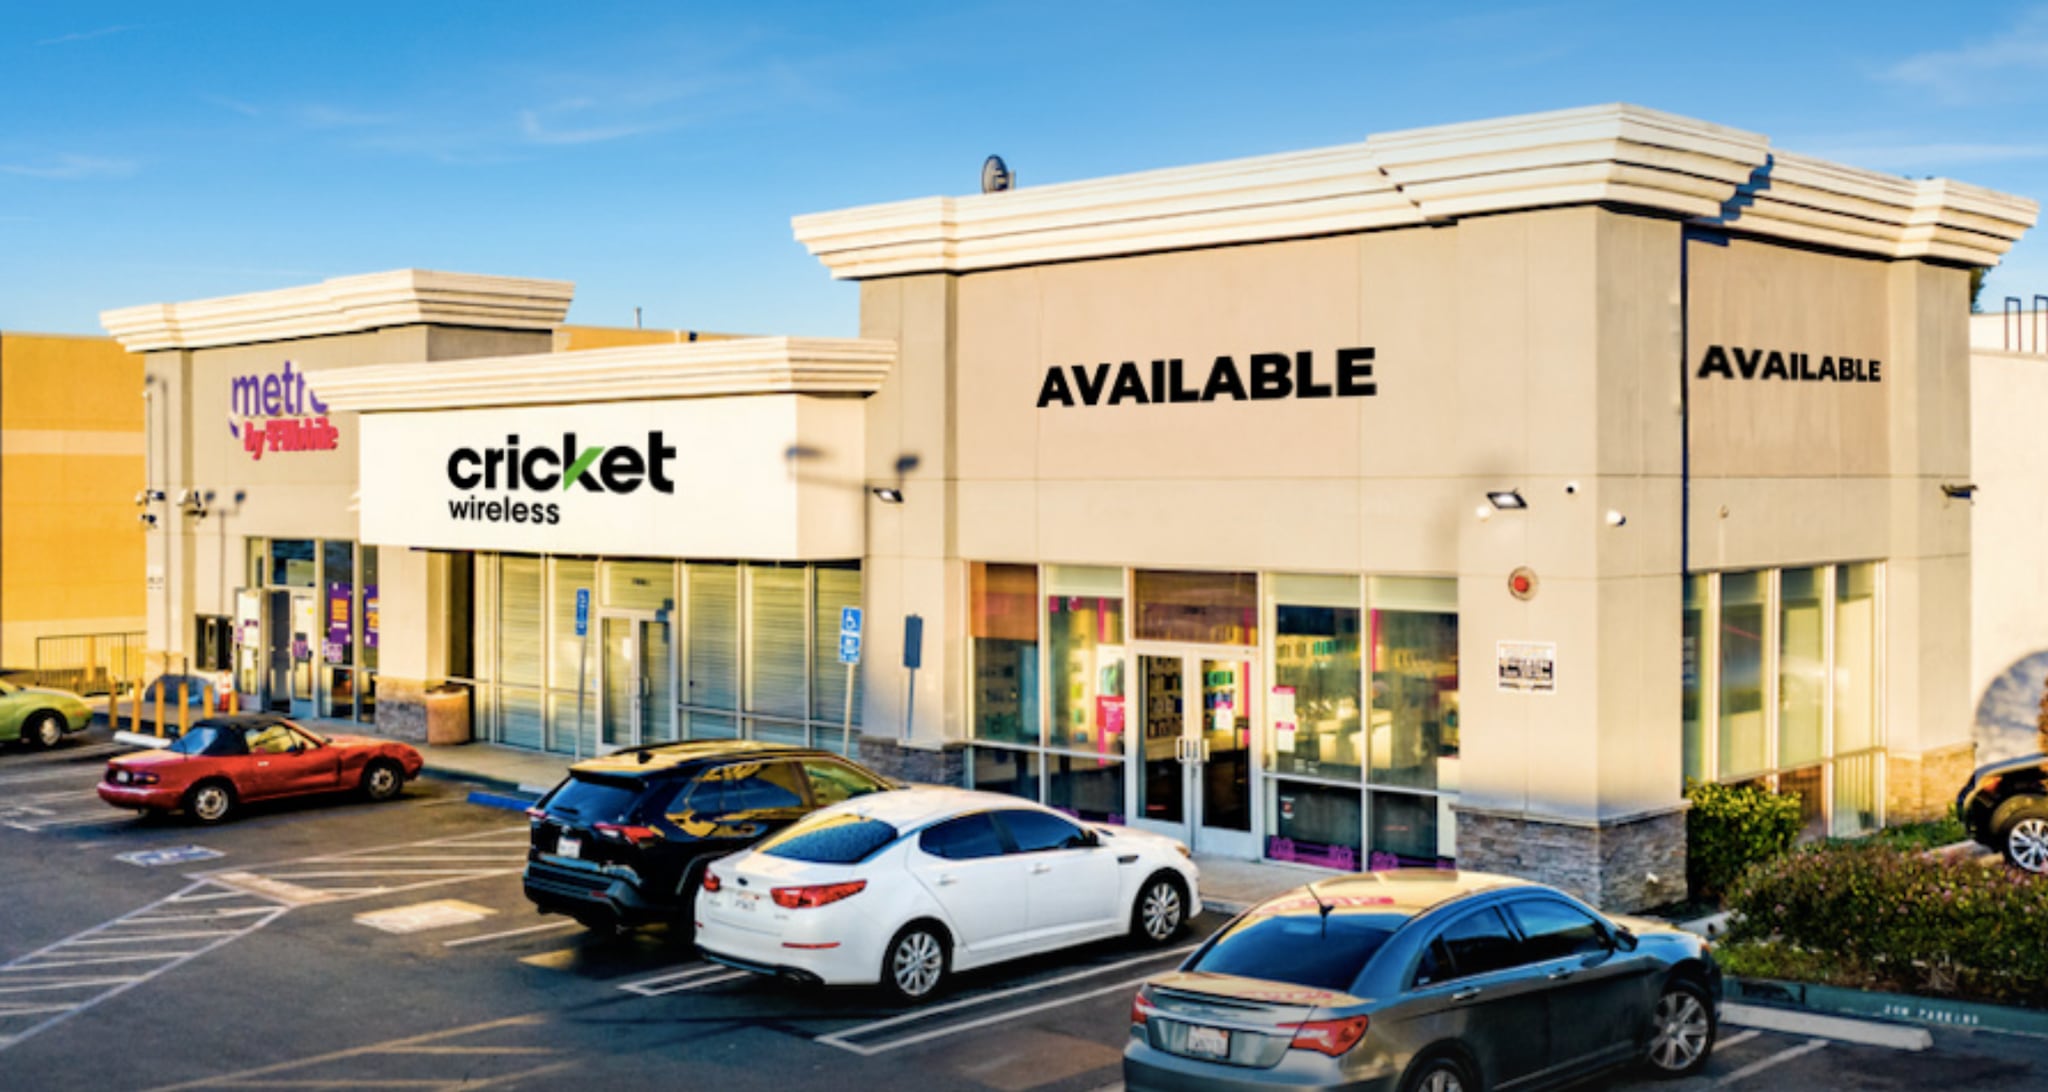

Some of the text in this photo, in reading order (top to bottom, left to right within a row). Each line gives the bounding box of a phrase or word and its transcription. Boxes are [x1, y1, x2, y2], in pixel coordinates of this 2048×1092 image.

[1036, 347, 1378, 408] AVAILABLE
[1697, 345, 1882, 382] AVAILABLE
[244, 421, 266, 461] by
[446, 430, 677, 495] cricket
[447, 495, 560, 525] wireless
